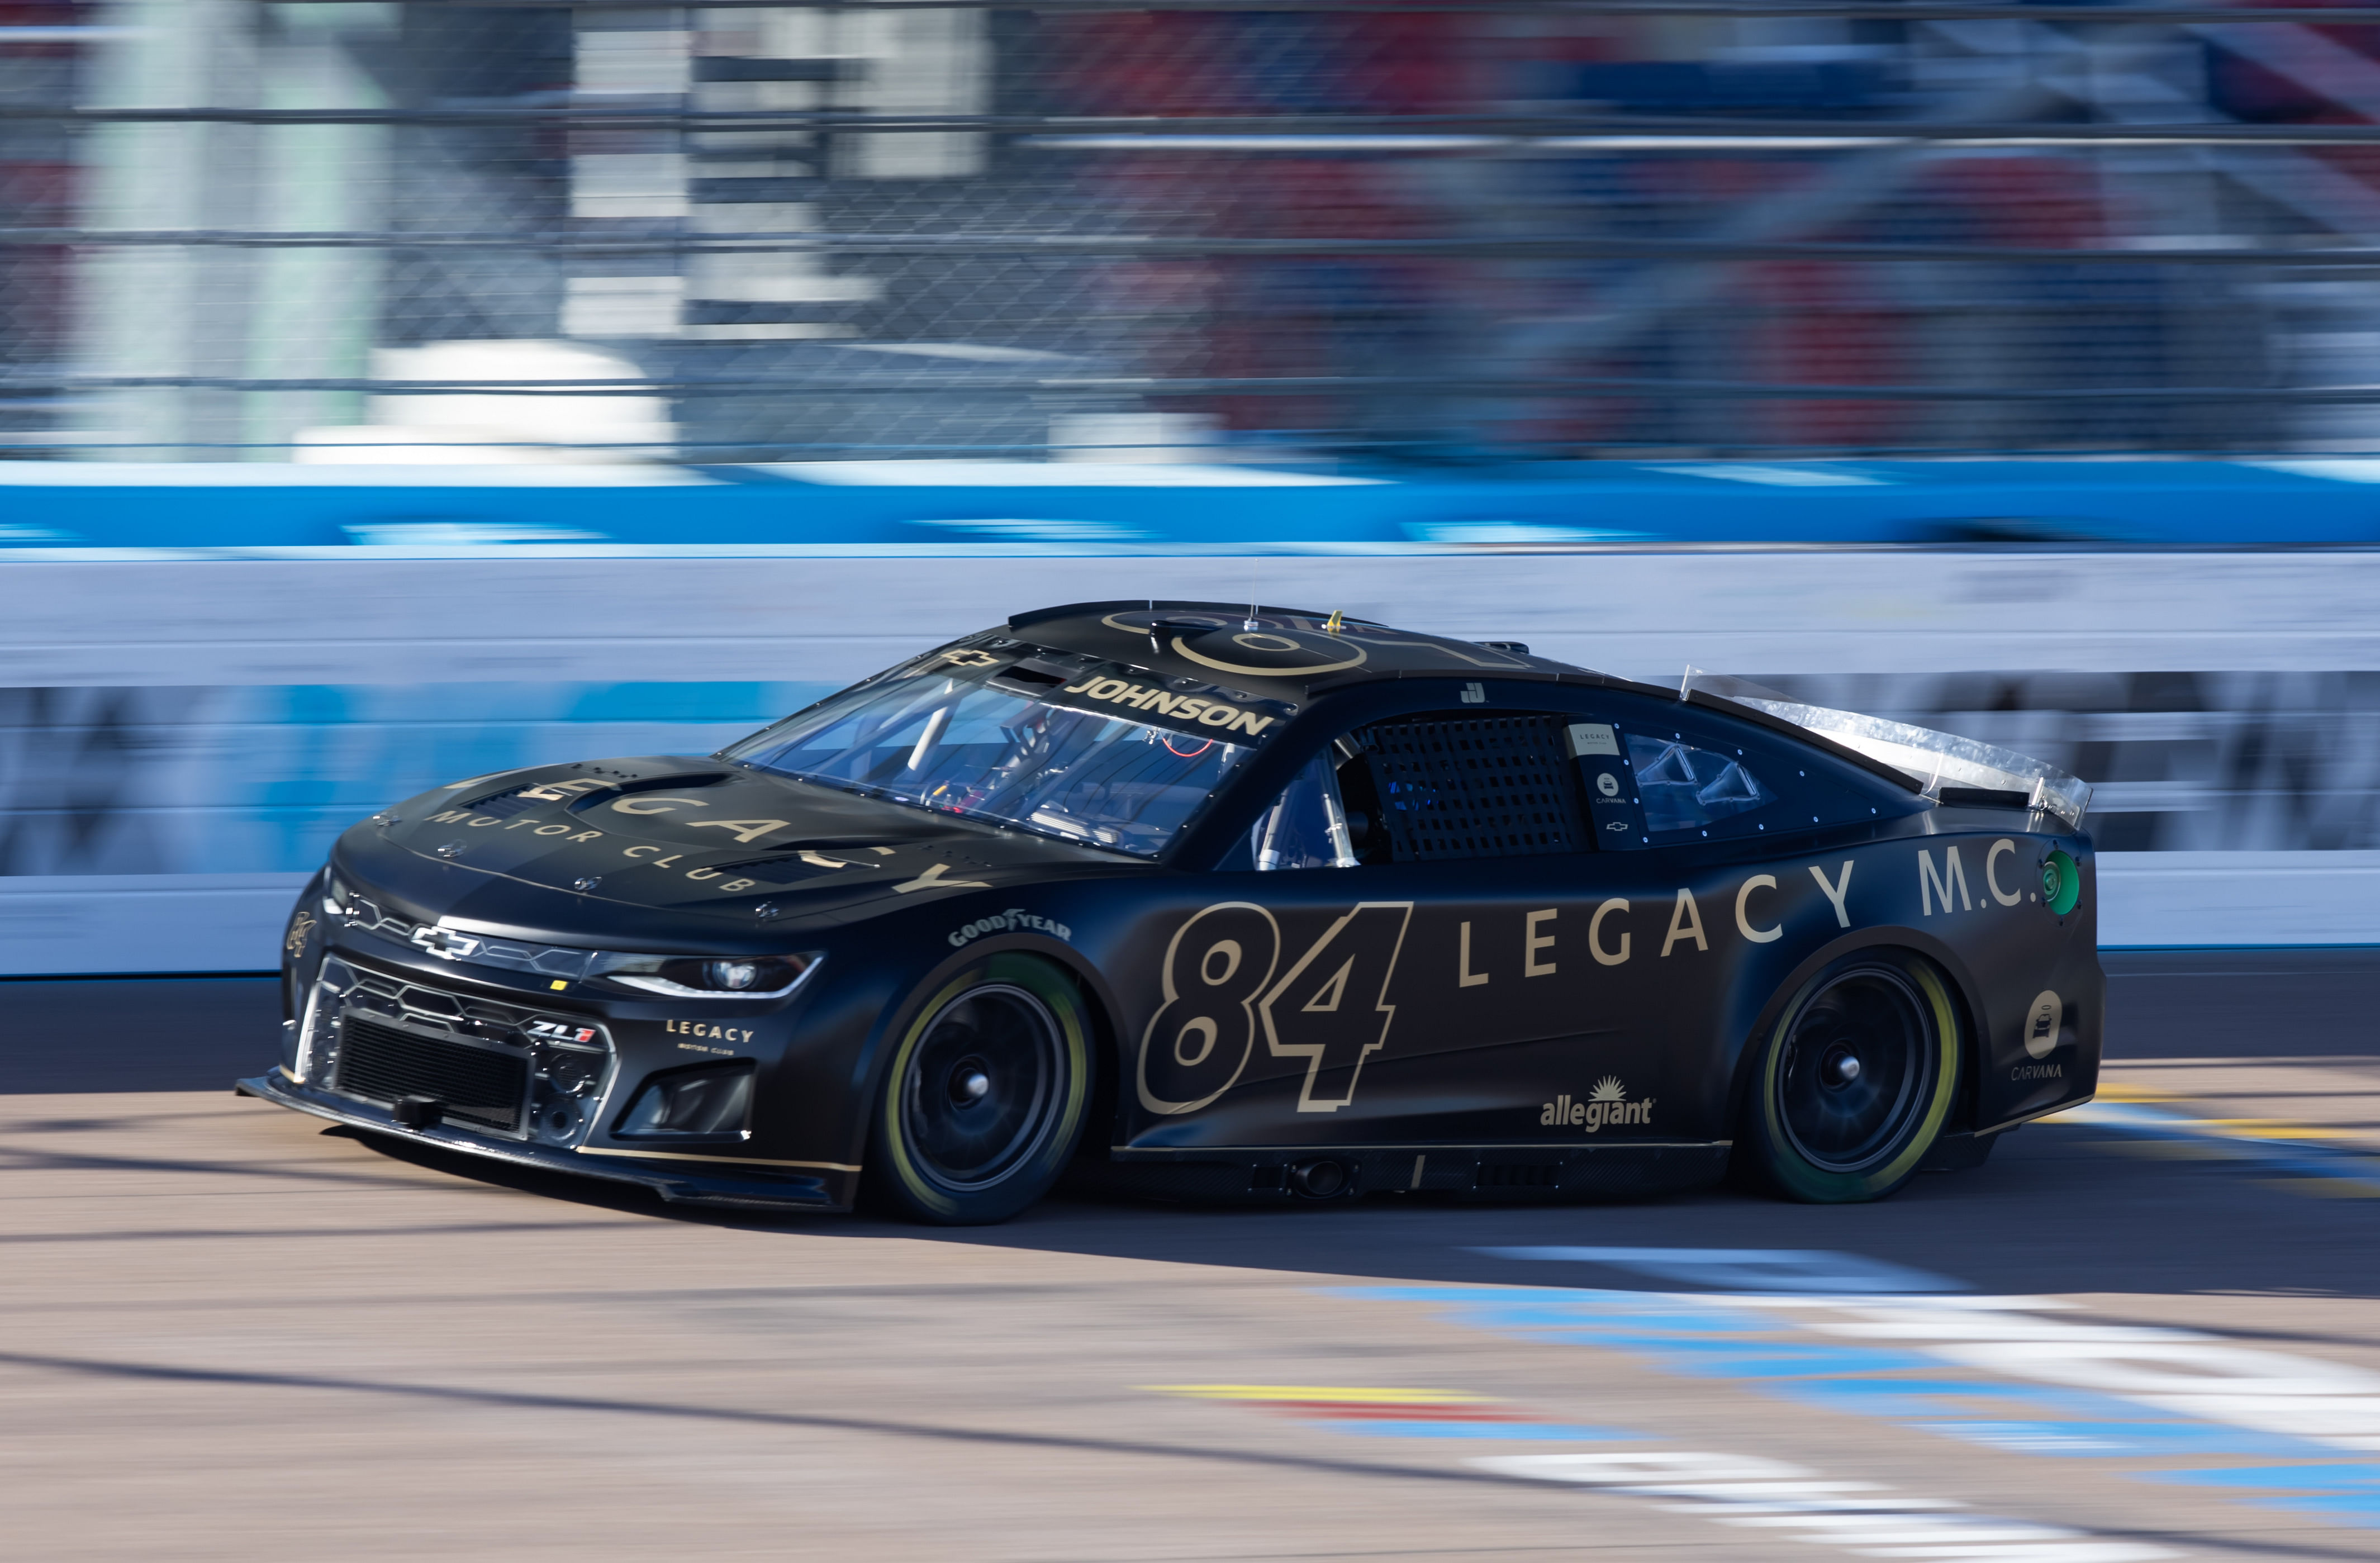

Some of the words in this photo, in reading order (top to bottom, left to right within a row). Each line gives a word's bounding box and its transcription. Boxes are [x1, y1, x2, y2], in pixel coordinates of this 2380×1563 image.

[1065, 676, 1274, 738] JOHNSON
[423, 810, 604, 843] MOTOR
[623, 845, 756, 891] CLUB
[948, 909, 1072, 947] GOODYEAR
[1459, 860, 1855, 988] LEGACY
[1918, 838, 2036, 916] M.C.
[1137, 901, 1414, 1114] 84
[527, 1020, 596, 1042] ZL1
[666, 1019, 754, 1043] LEGACY
[2011, 1063, 2062, 1081] CARVANA
[1540, 1095, 1652, 1133] allegiant
